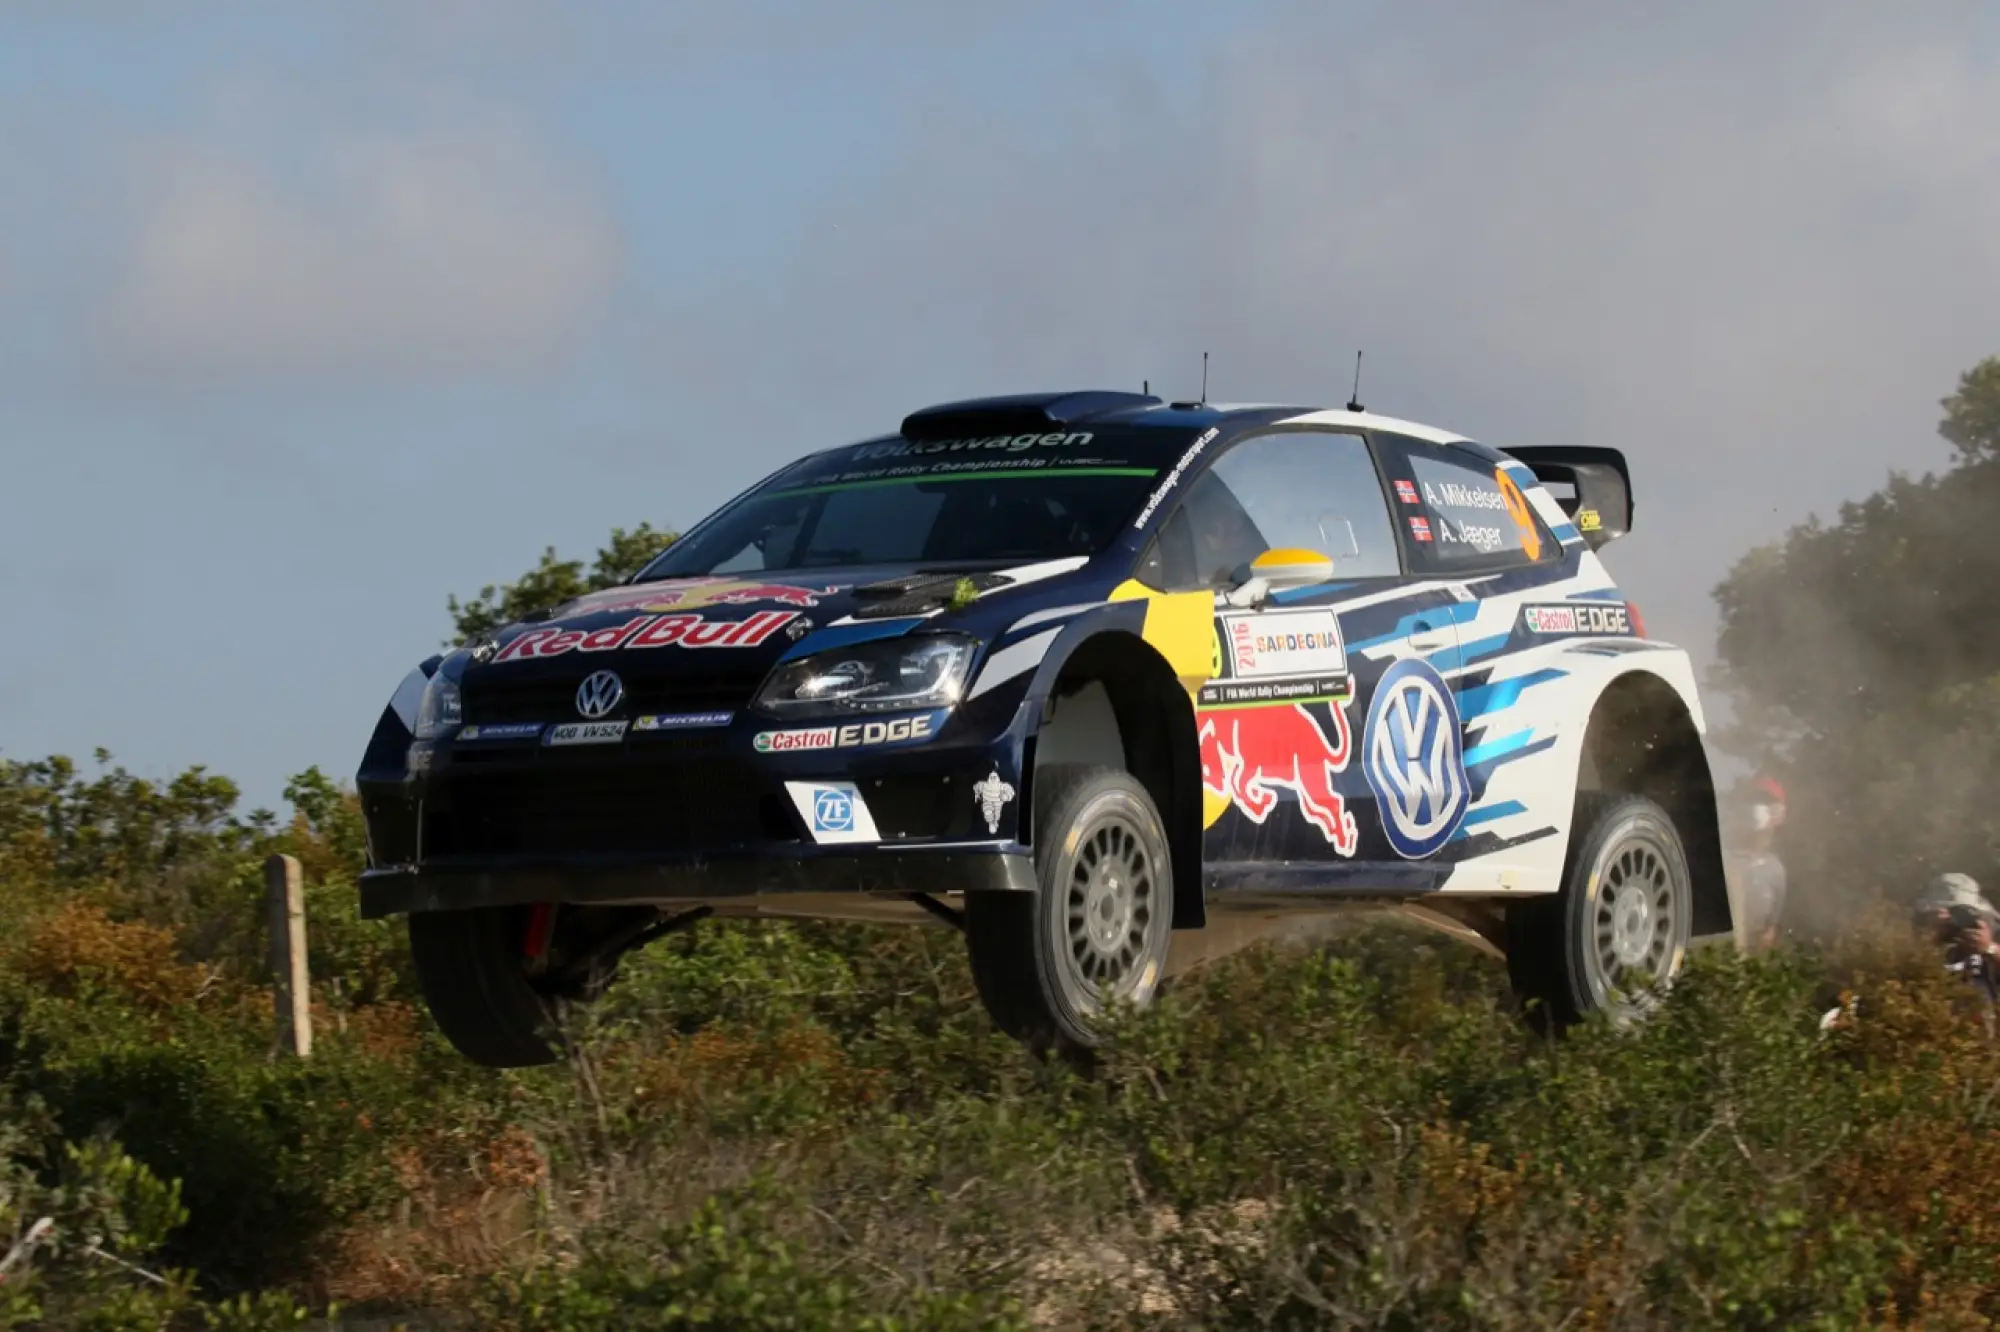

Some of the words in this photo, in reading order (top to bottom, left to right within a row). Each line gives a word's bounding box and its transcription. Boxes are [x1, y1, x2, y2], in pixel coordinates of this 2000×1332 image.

[1424, 481, 1442, 505] A.
[1438, 483, 1509, 510] Mikkelsen
[1440, 518, 1457, 542] A.
[1537, 607, 1576, 630] Castrol
[1575, 607, 1629, 632] EDGE
[1256, 632, 1337, 653] SARDEGNA
[661, 713, 730, 725] MICHELIN
[771, 730, 833, 750] Castrol
[838, 713, 932, 748] EDGE
